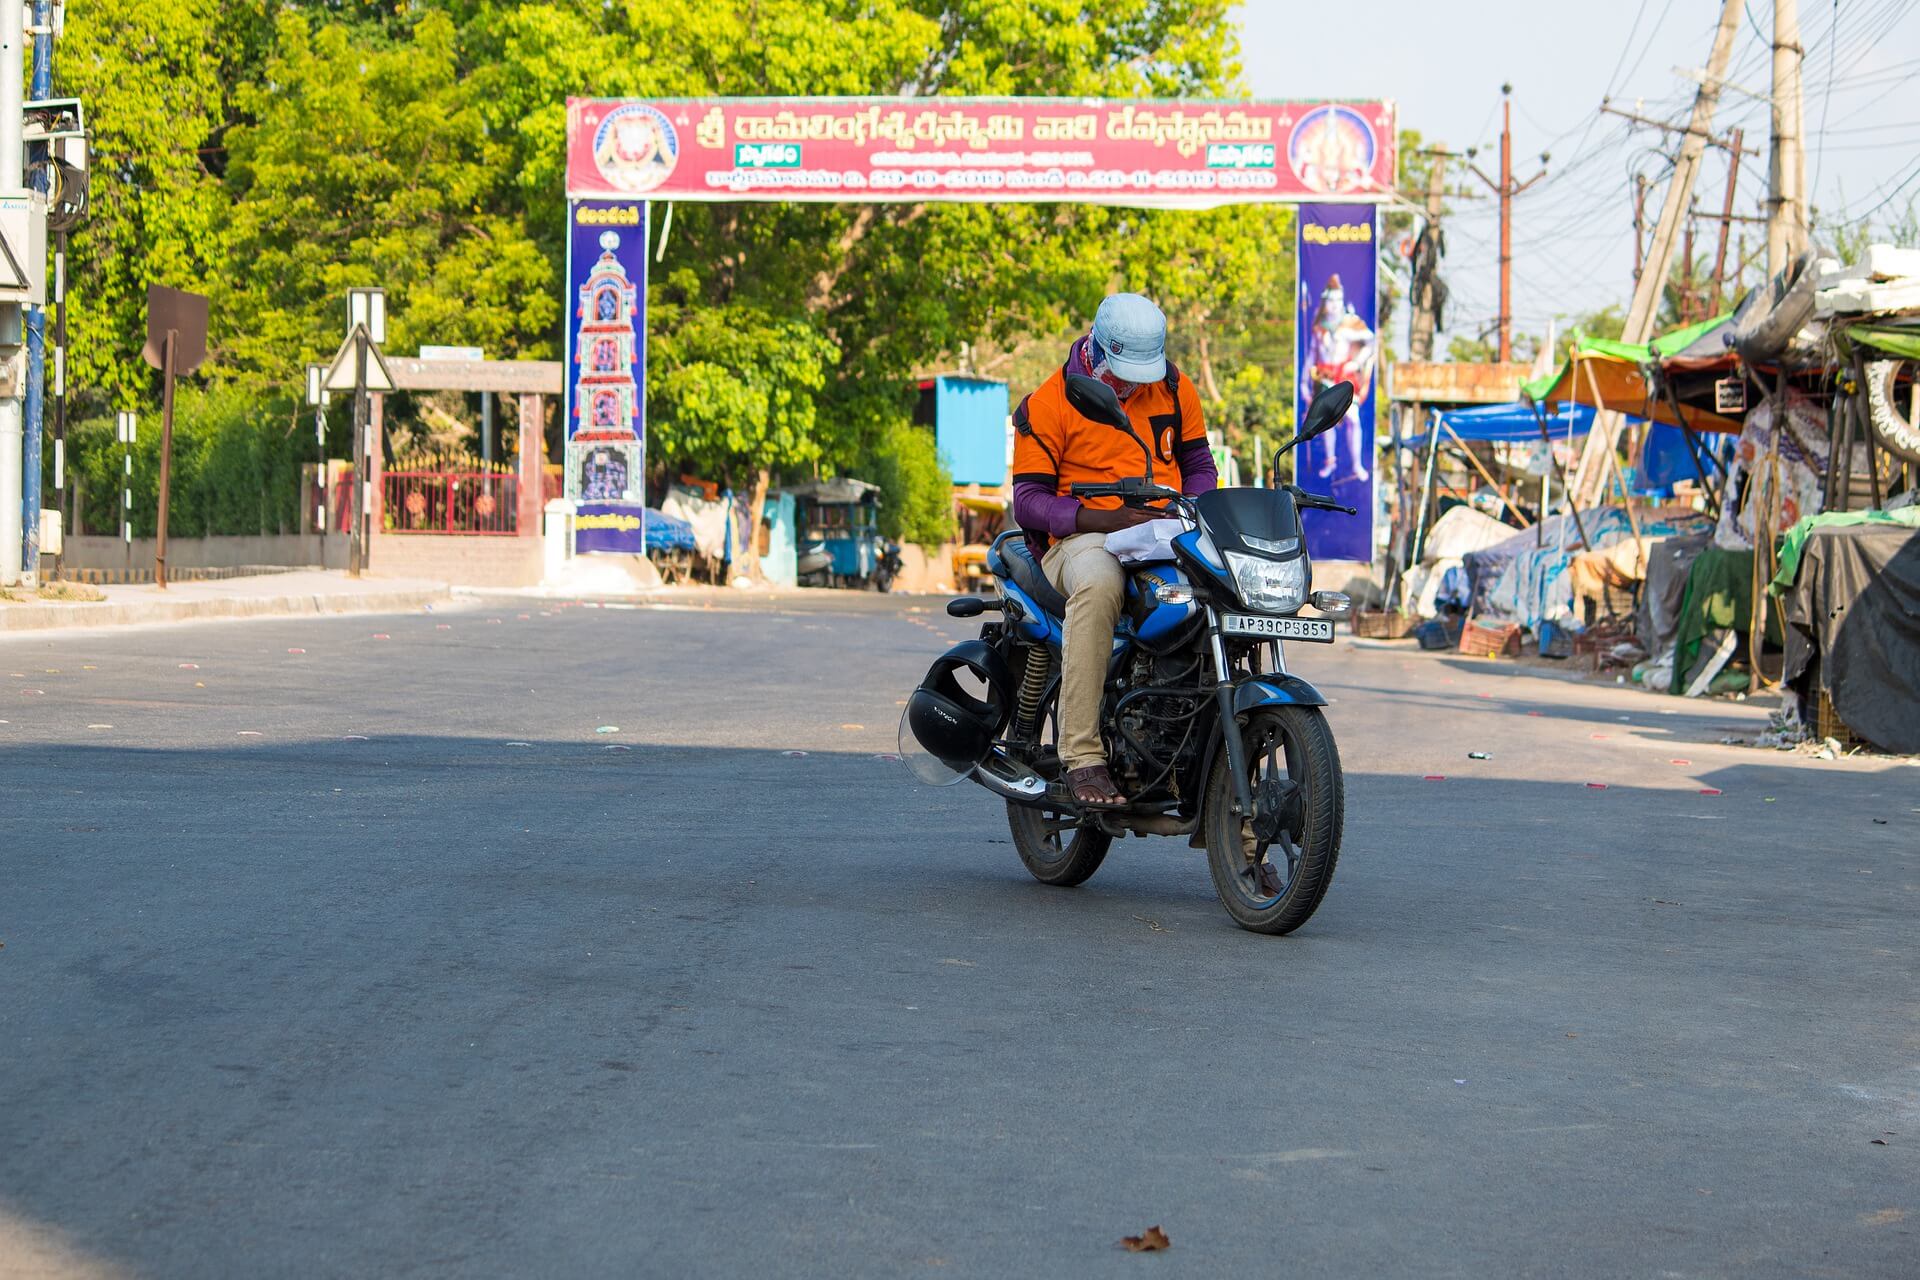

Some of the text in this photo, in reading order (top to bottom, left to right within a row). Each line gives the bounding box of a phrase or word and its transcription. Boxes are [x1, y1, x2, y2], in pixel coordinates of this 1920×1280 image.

[697, 107, 725, 149] శ్రీ
[1033, 115, 1097, 141] వారి
[1239, 617, 1328, 637] AP39CP5859
